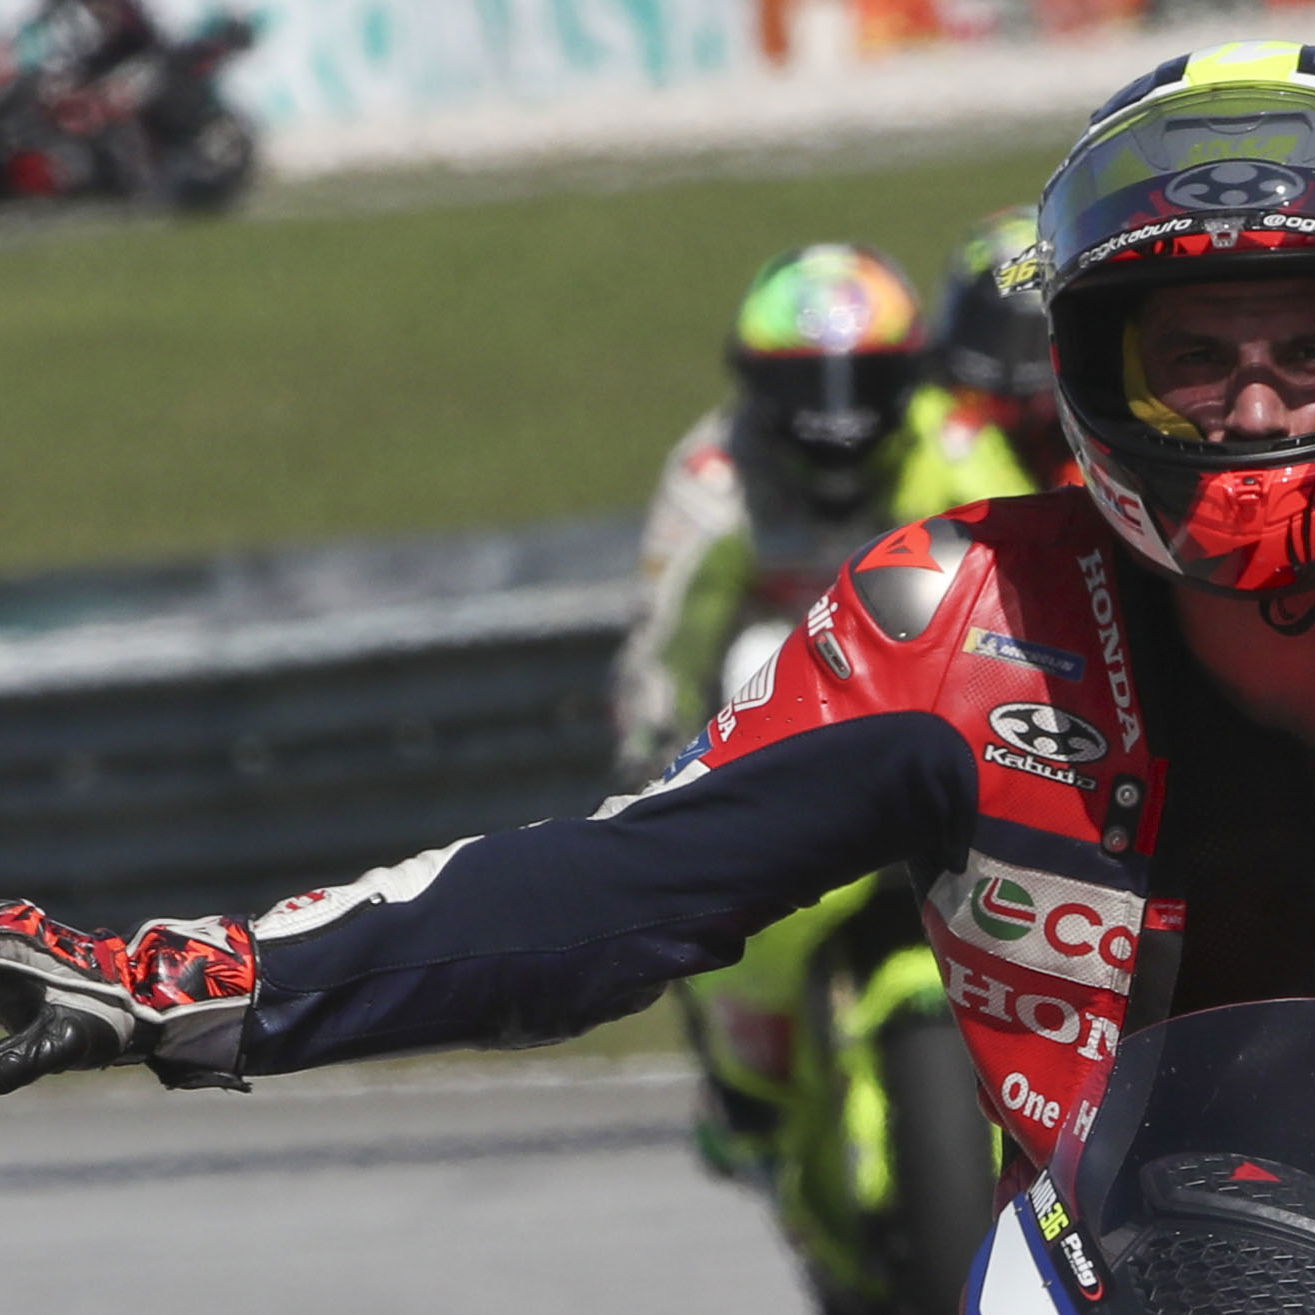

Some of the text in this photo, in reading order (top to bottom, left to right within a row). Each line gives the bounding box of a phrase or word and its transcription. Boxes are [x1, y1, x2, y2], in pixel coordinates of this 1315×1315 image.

[1077, 549, 1141, 753] HONDA
[984, 744, 1097, 790] Kabuto
[1001, 1071, 1061, 1129] One
[1064, 1232, 1097, 1287] Puig
